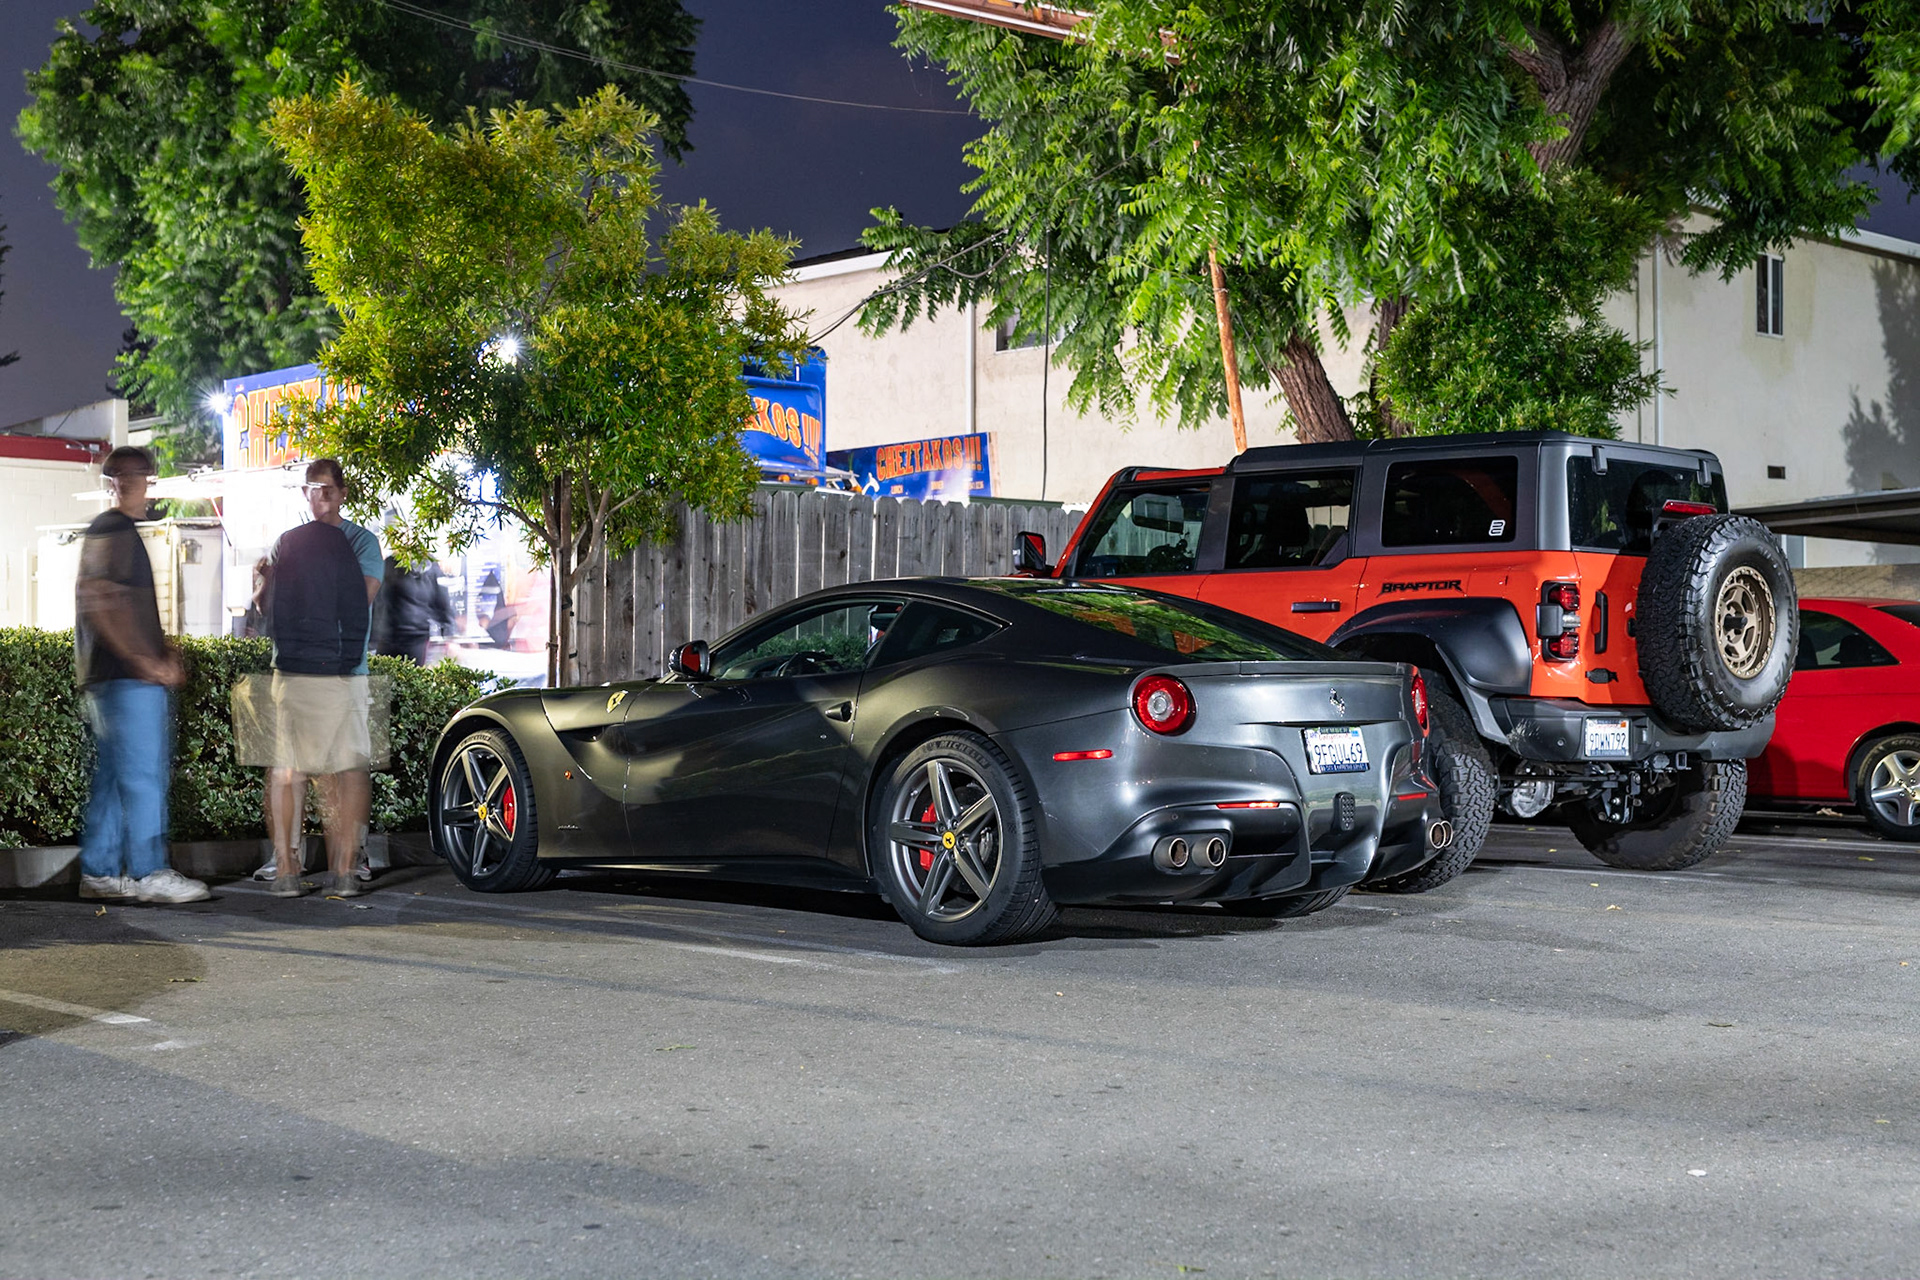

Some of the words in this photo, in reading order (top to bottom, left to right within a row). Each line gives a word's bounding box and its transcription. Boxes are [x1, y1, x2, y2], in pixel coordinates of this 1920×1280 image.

[876, 436, 983, 481] CHEZTAKOS!!!
[939, 740, 989, 767] MICHELIN
[1314, 742, 1363, 765] 9FGUL69
